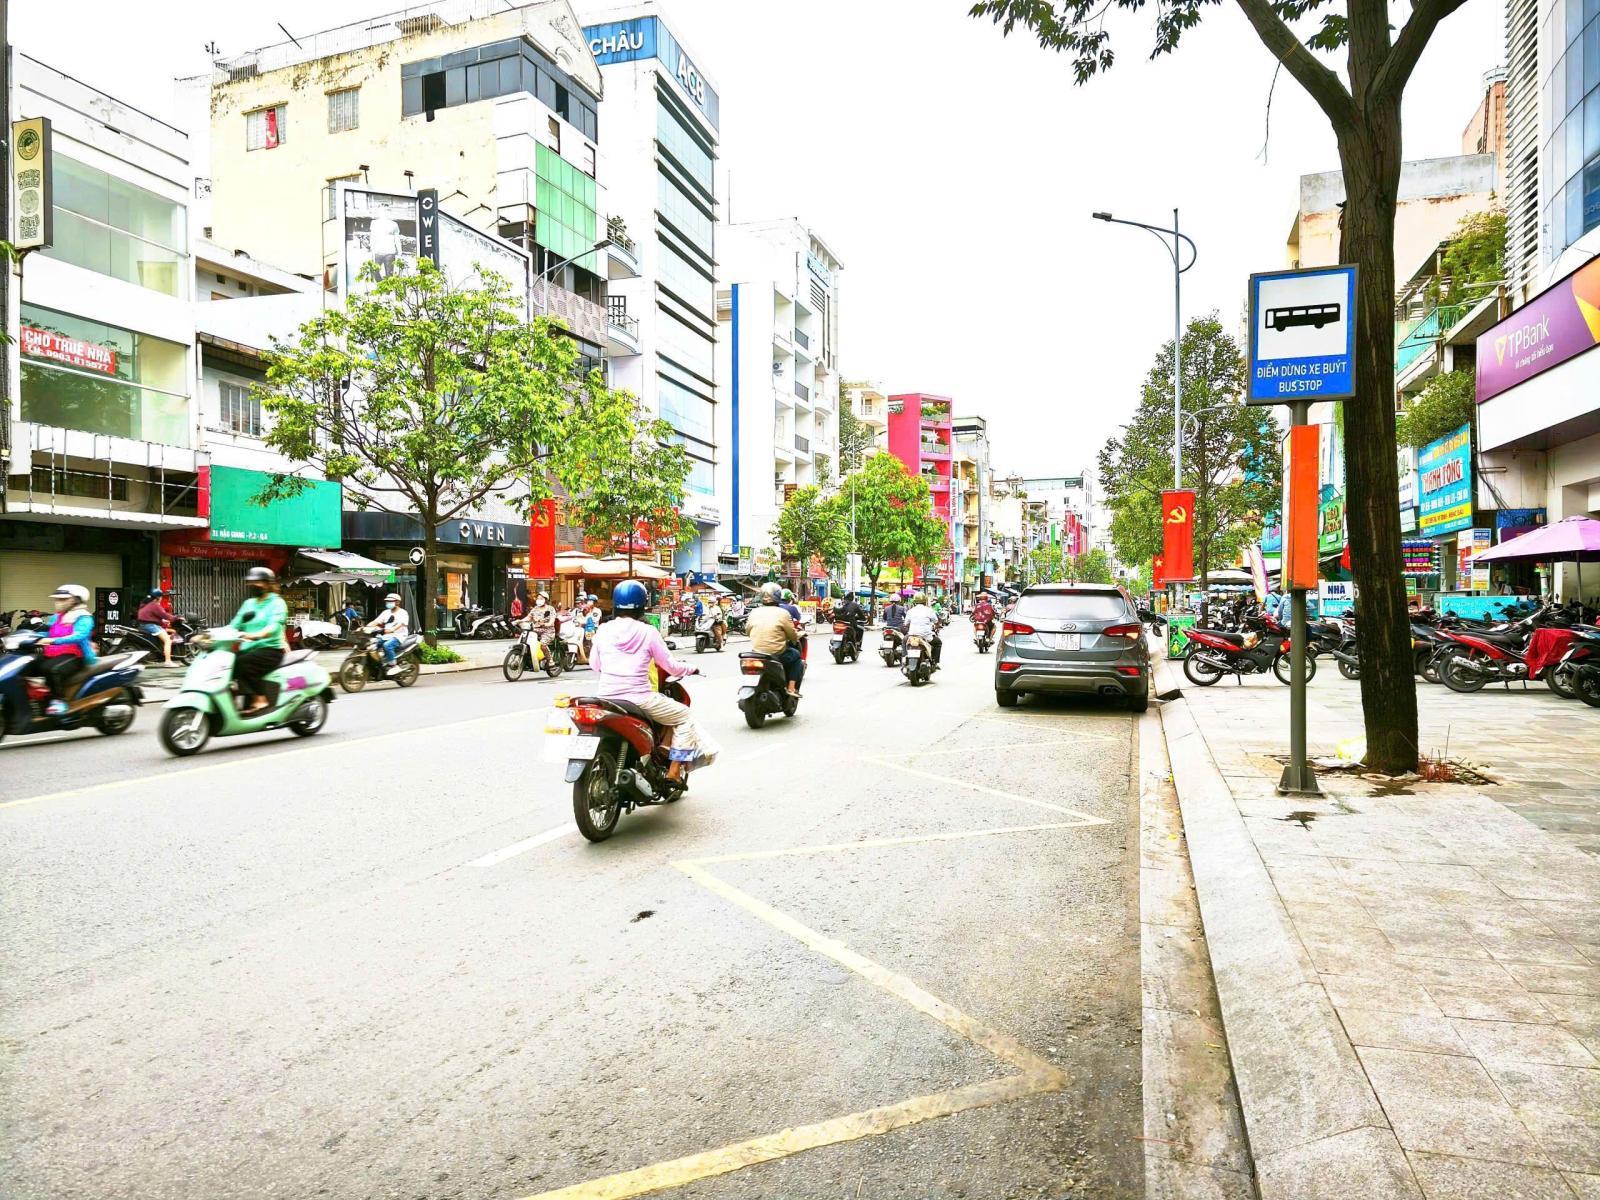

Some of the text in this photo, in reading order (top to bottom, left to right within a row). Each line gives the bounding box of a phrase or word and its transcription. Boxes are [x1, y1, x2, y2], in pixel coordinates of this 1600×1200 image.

[588, 30, 644, 56] CHÂU
[676, 52, 704, 105] ACB
[25, 330, 51, 347] CHO
[1509, 314, 1550, 357] TPBank
[1257, 360, 1347, 378] ĐIỂM DỪNG XE BUÝT
[1279, 379, 1323, 392] BUS STOP
[459, 521, 505, 541] OWEN
[1327, 583, 1346, 594] NHÀ
